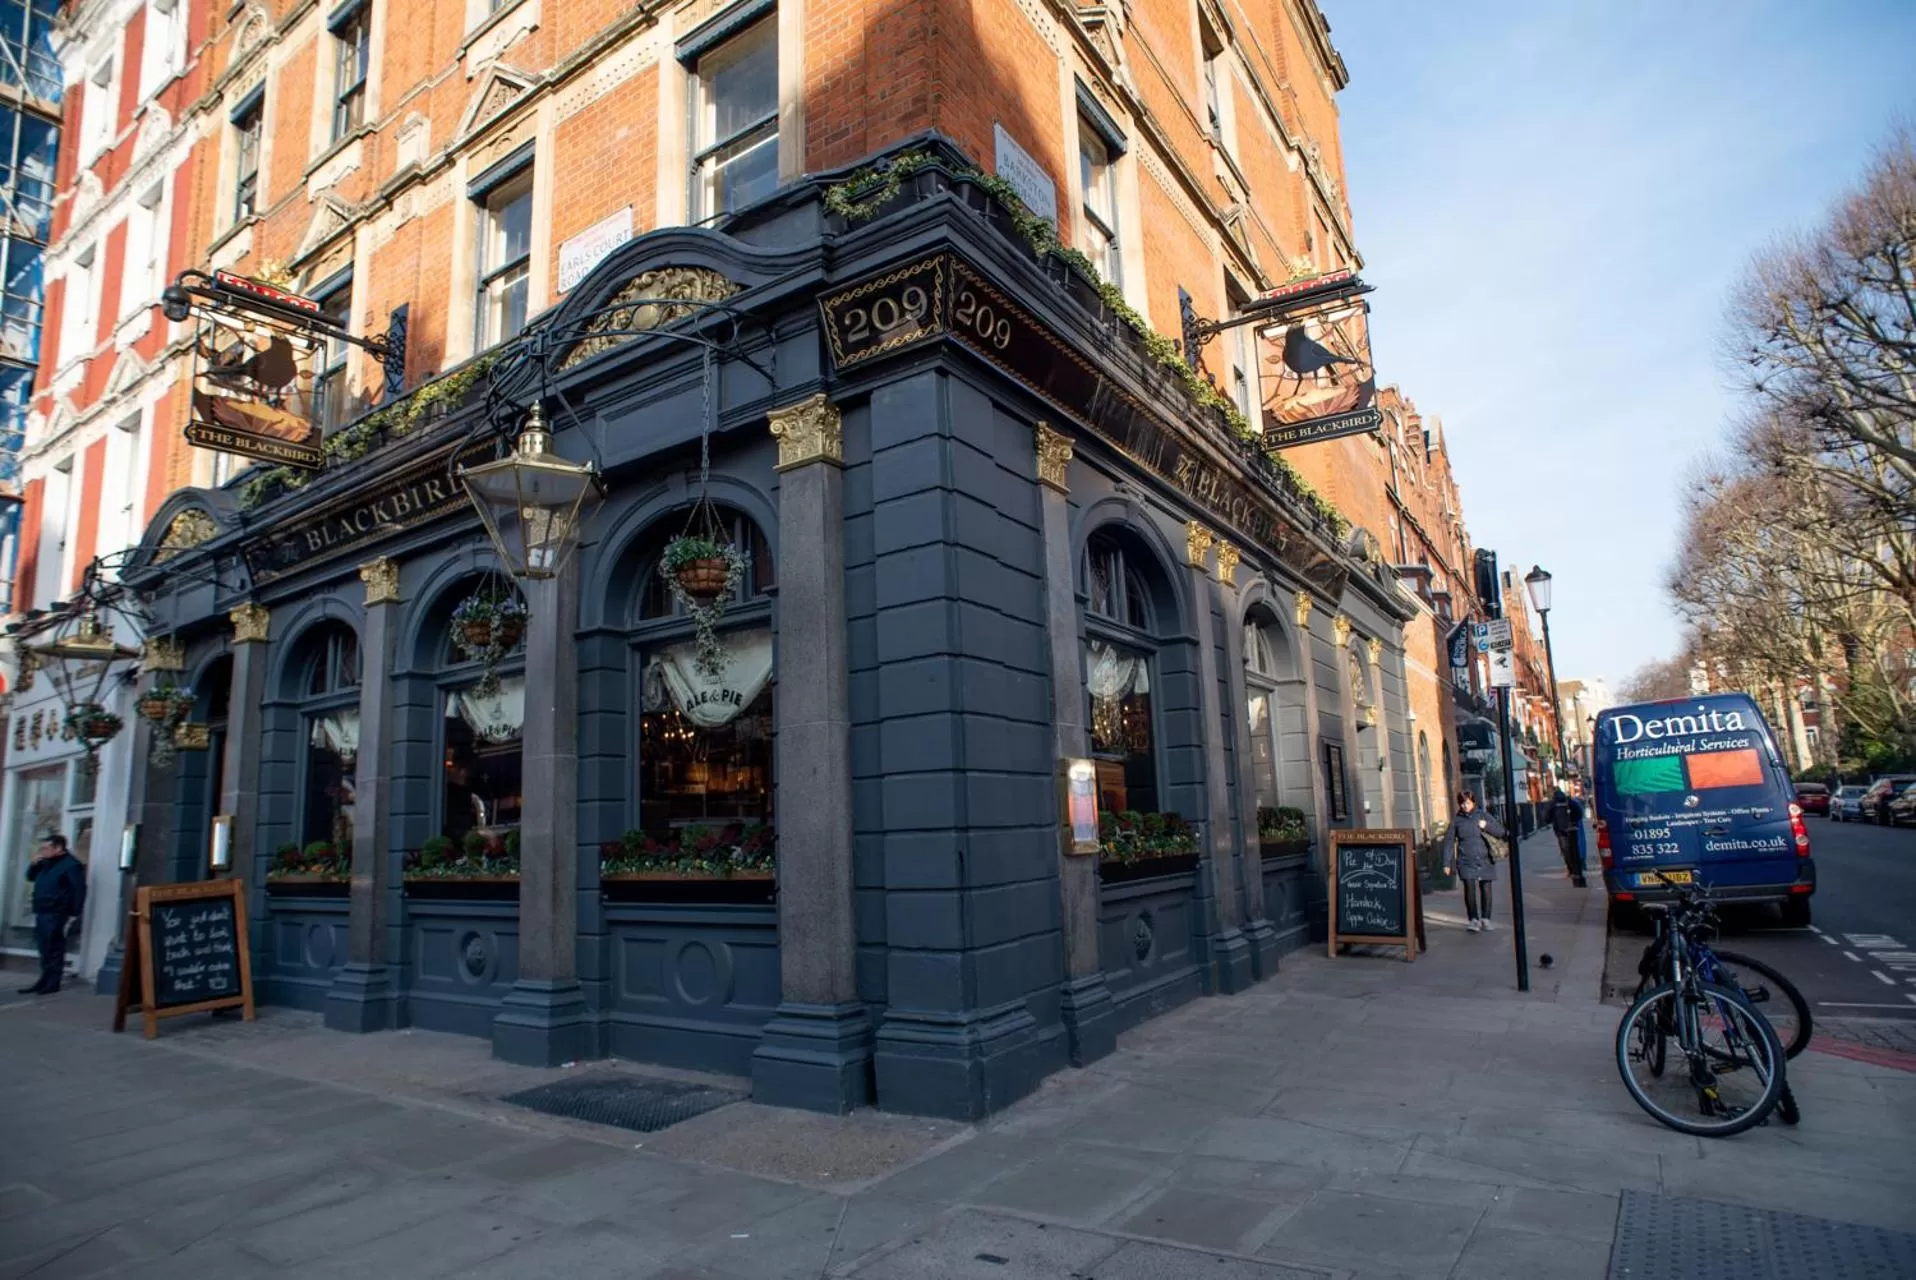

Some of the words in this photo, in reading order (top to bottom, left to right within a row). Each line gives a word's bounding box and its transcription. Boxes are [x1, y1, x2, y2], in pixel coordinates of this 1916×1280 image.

[593, 228, 630, 257] COURT
[844, 286, 928, 343] 209
[955, 291, 1011, 350] 209
[1270, 430, 1298, 443] THE
[1299, 415, 1373, 437] BLACKBIRD
[199, 430, 233, 446] THE
[235, 437, 317, 462] BLACKBIRD
[686, 691, 708, 713] ALE
[721, 689, 744, 707] PIE
[1609, 704, 1746, 745] Demita
[1616, 739, 1696, 761] Horticultural
[1699, 736, 1750, 751] Services
[1633, 827, 1671, 840] 01895
[1705, 836, 1787, 852] demita.co.uk
[1343, 850, 1357, 867] Pie
[1364, 850, 1375, 861] of
[1631, 842, 1654, 855] 835
[1656, 842, 1680, 854] 322
[1374, 852, 1397, 878] Day
